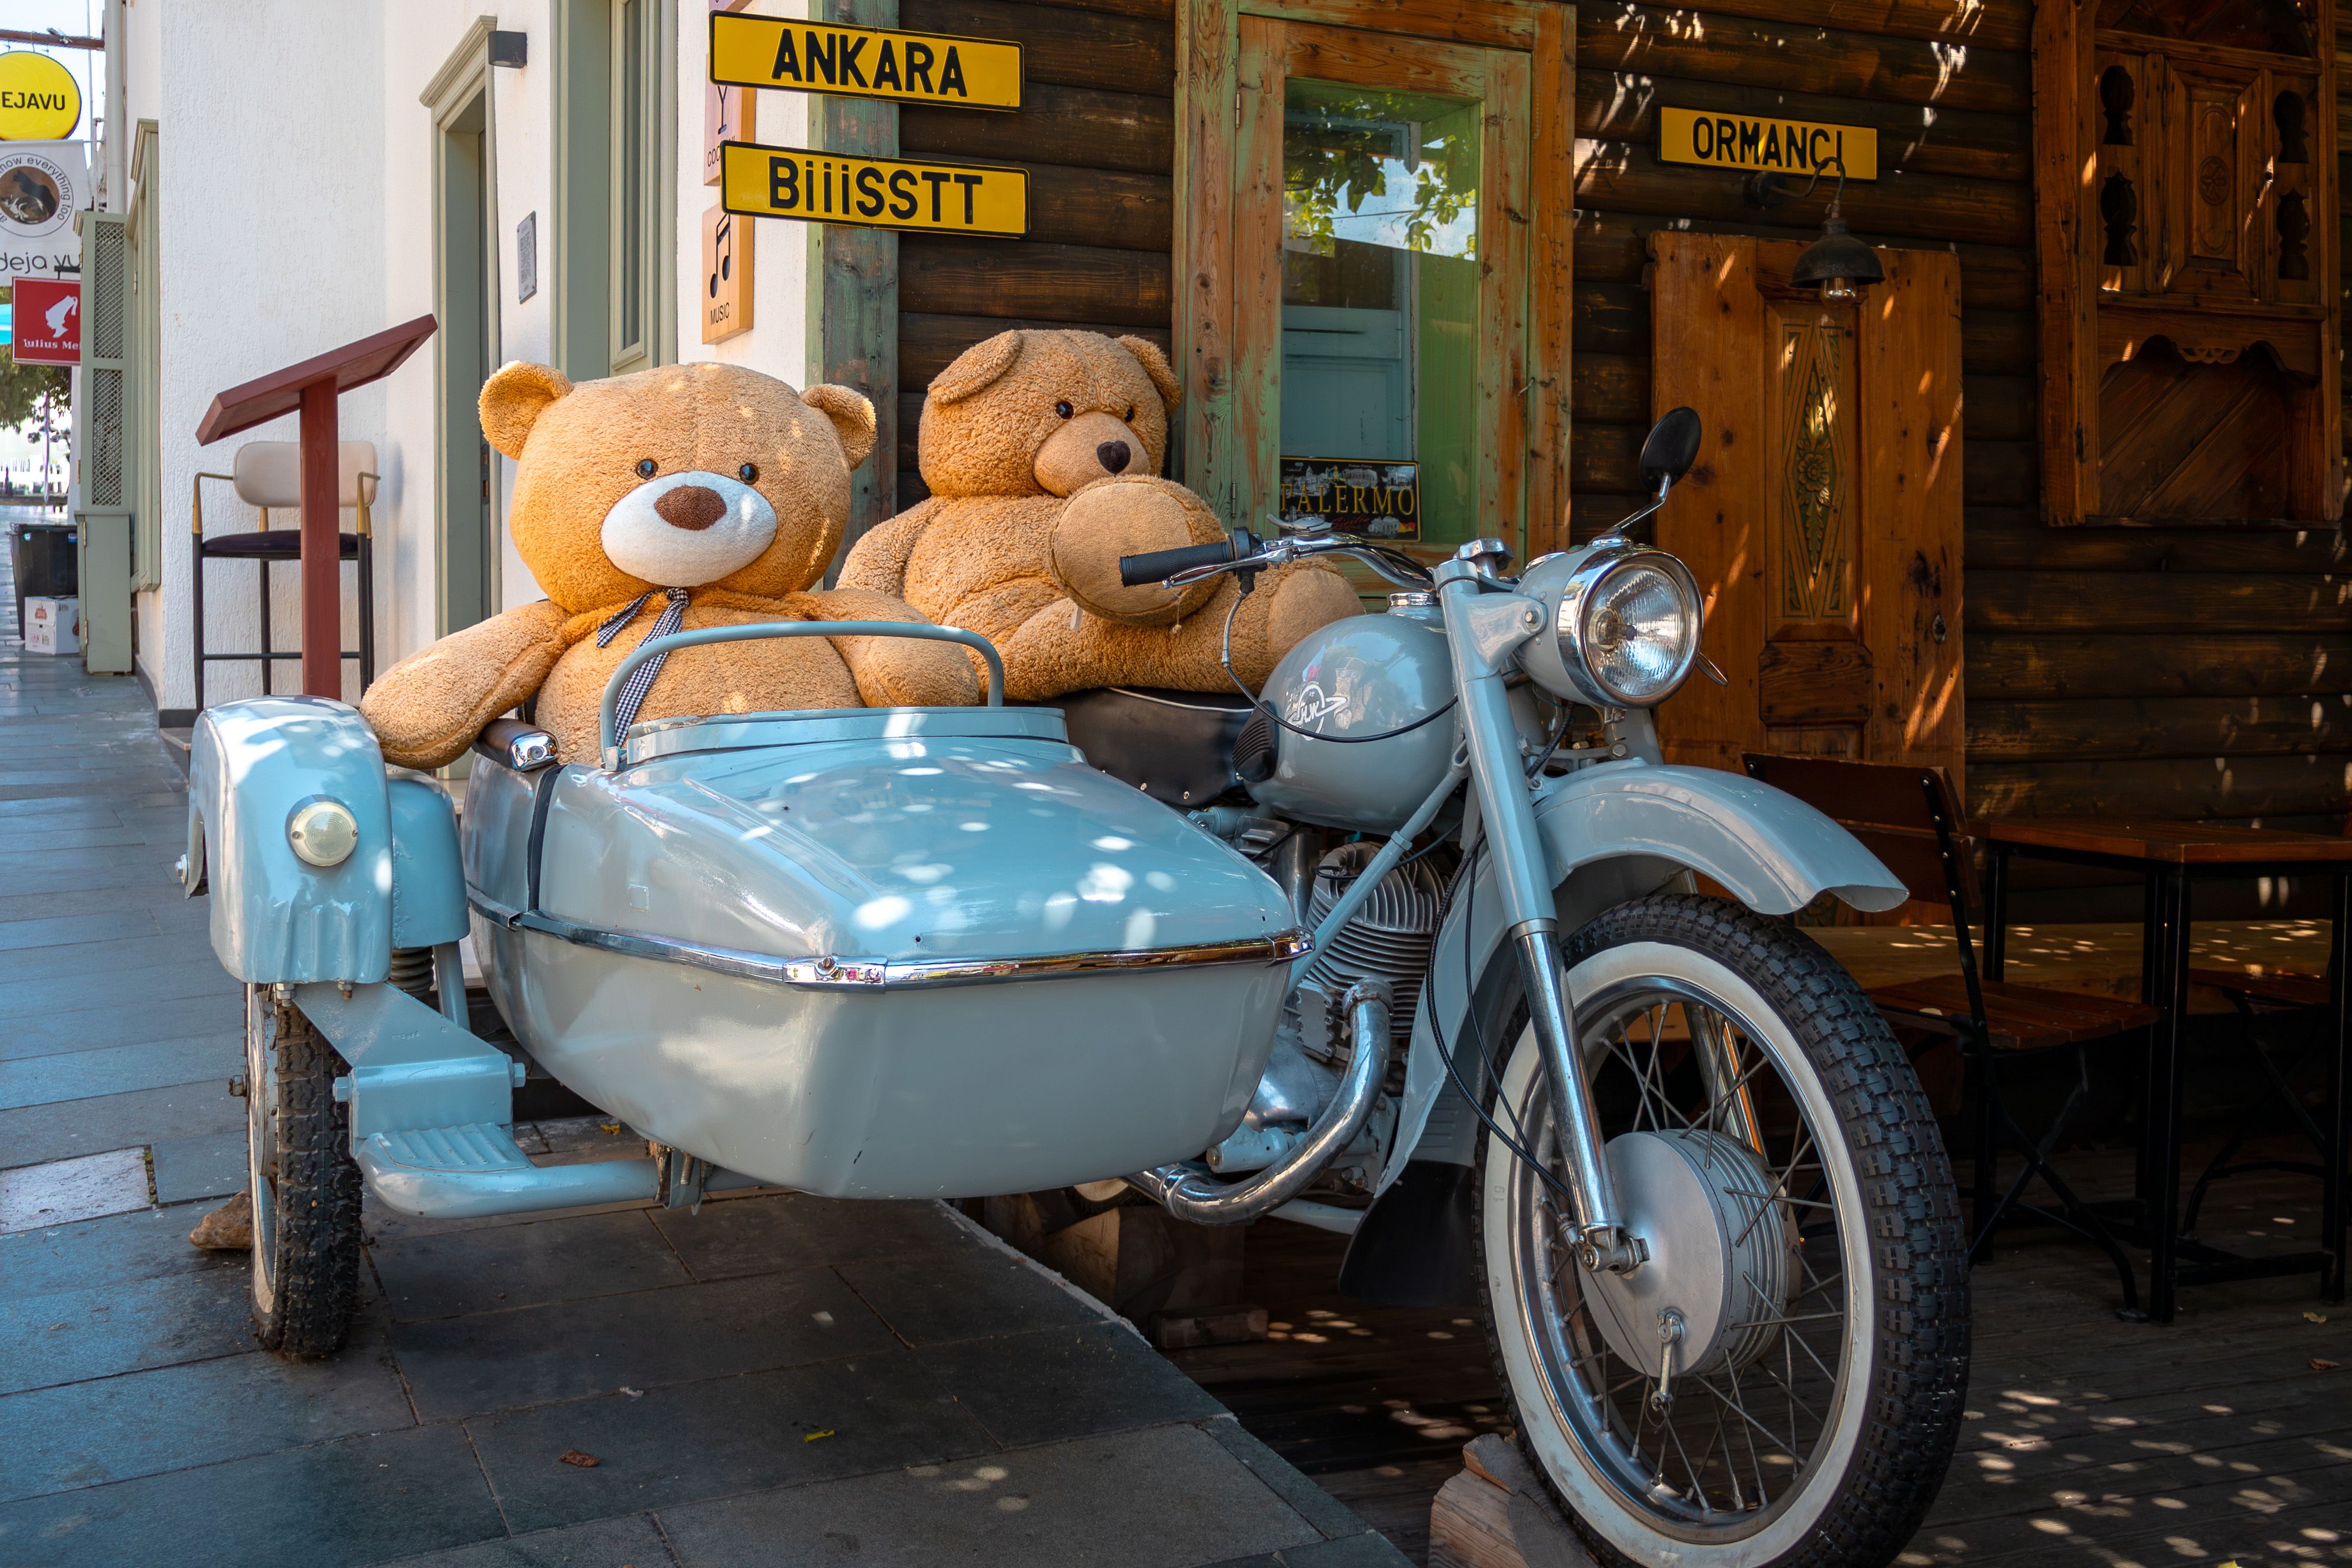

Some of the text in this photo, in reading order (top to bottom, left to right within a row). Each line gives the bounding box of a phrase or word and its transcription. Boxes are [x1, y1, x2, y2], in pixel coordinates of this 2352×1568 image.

[771, 28, 968, 98] ANKARA
[1692, 116, 1842, 172] ORMANCI
[0, 156, 72, 220] now everything too
[0, 252, 48, 274] deja
[710, 302, 730, 326] MUSIC
[1281, 483, 1415, 516] PALERMO
